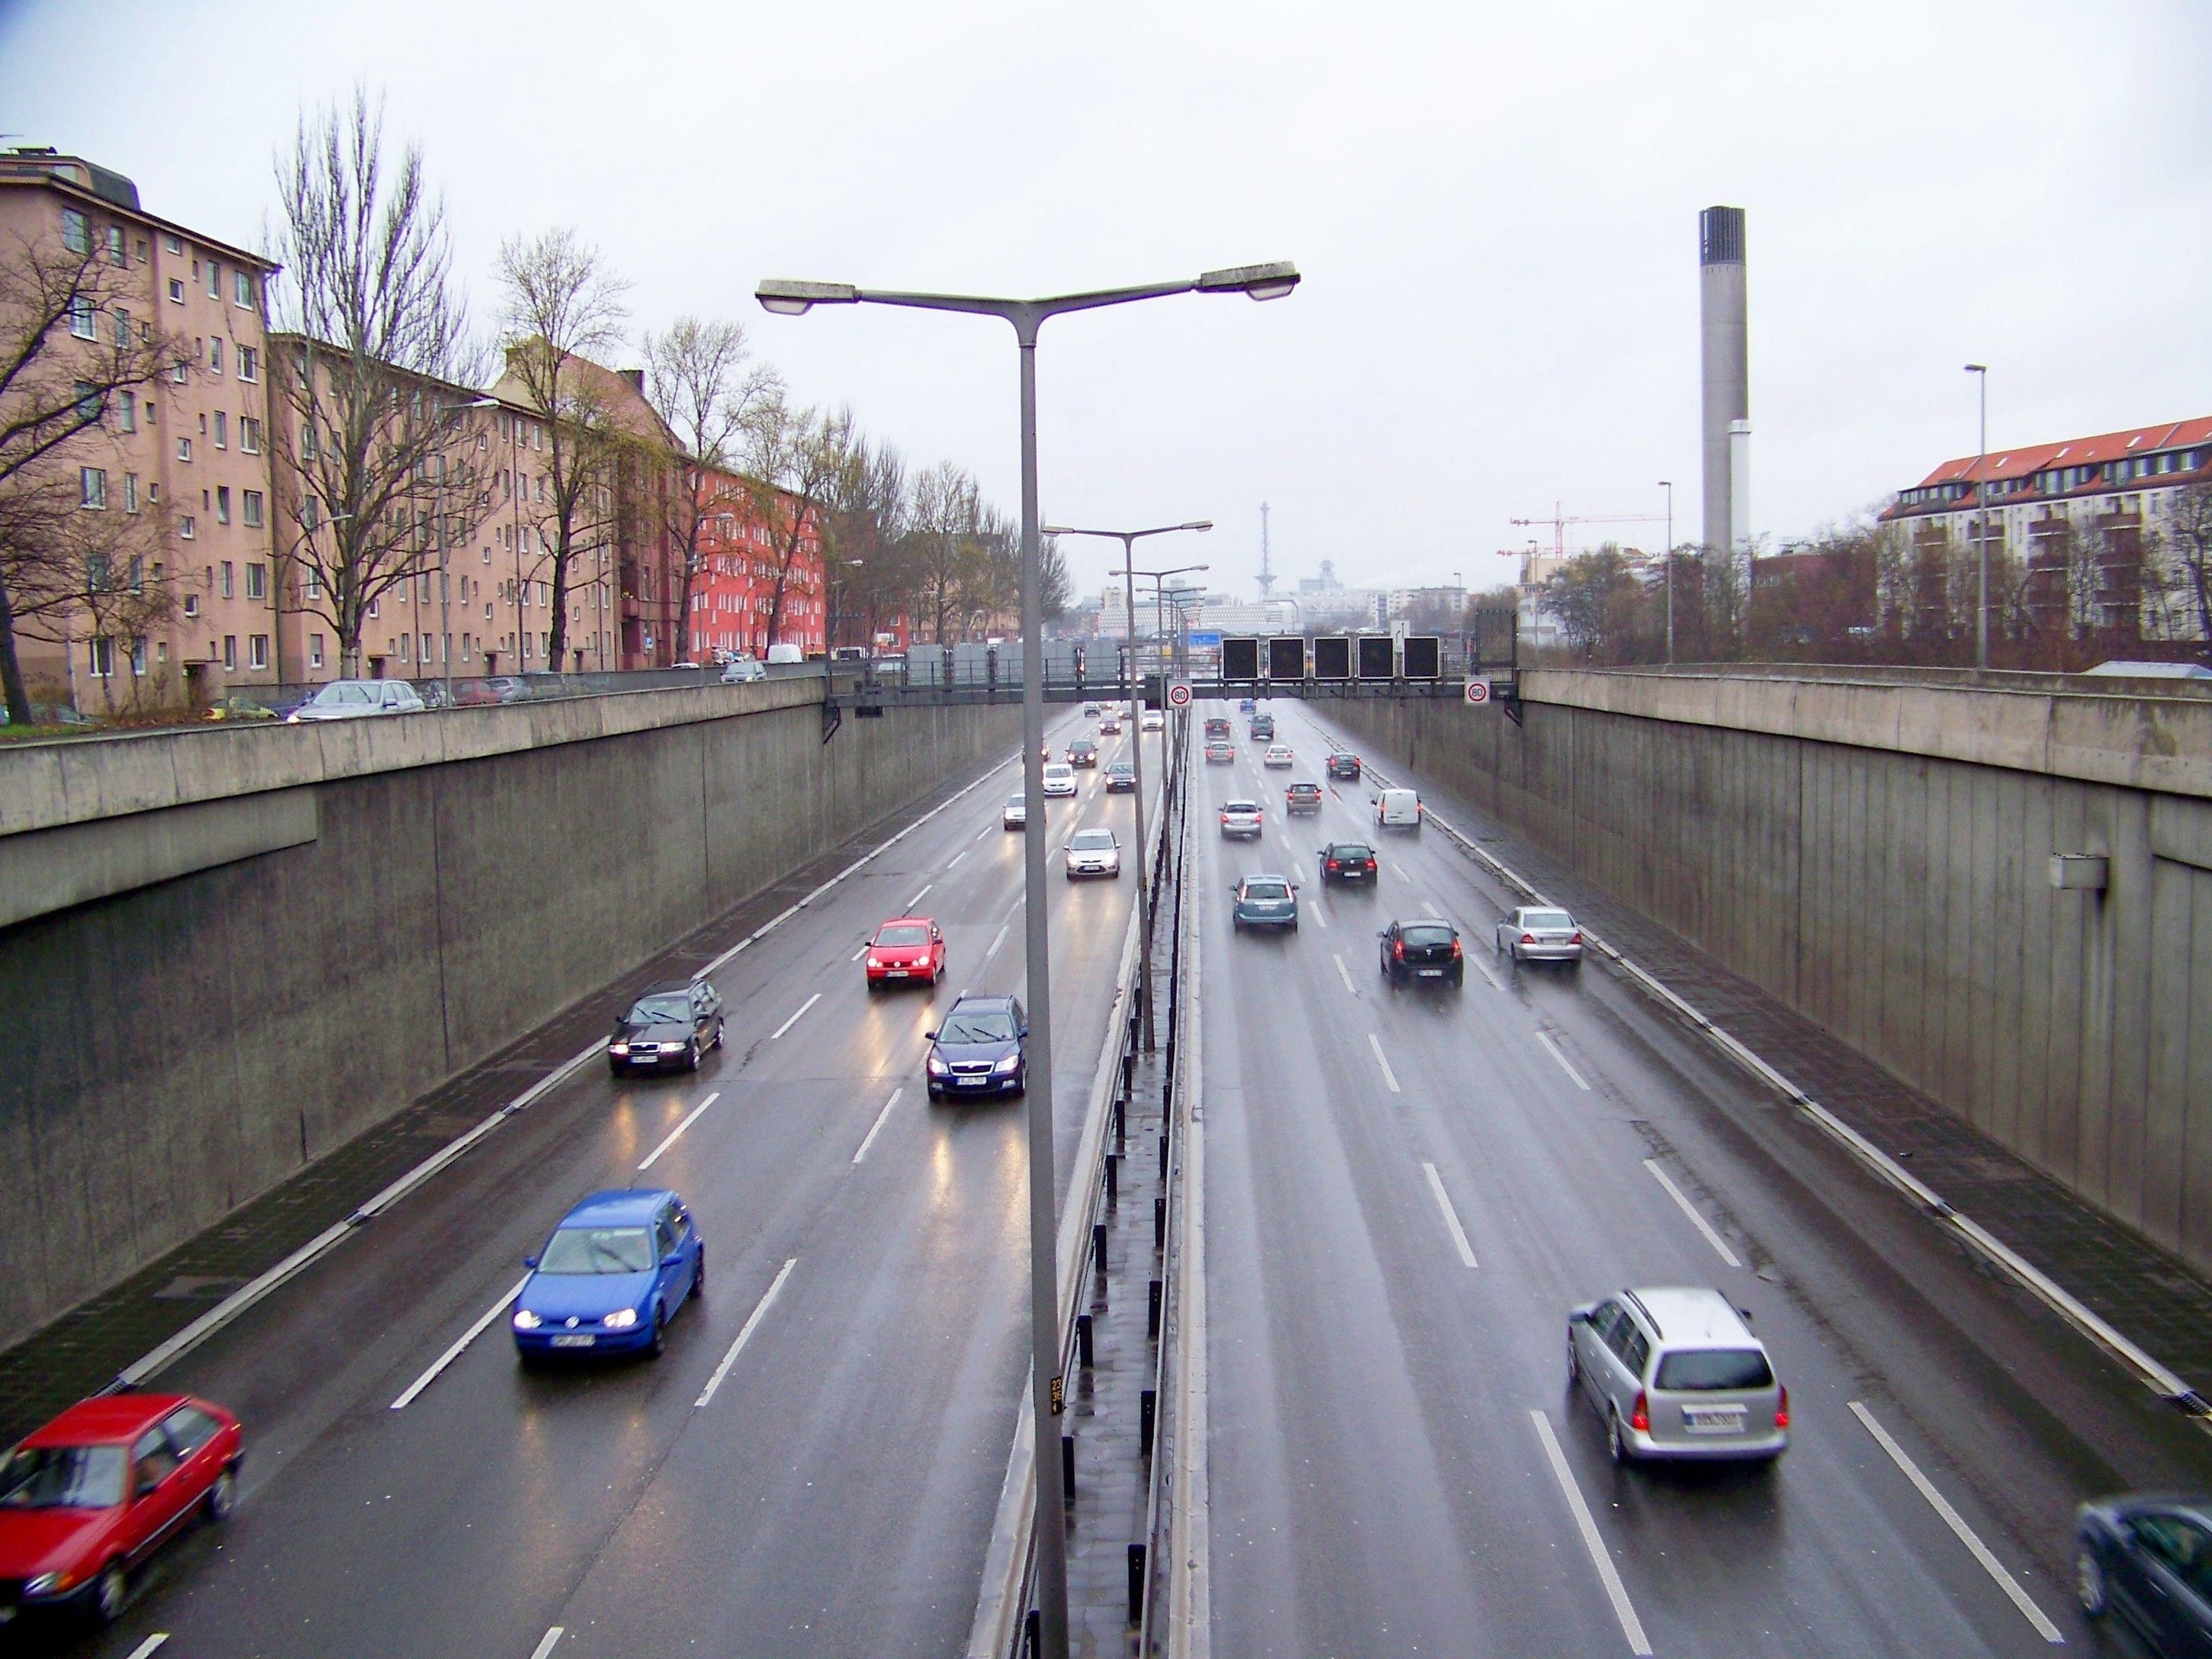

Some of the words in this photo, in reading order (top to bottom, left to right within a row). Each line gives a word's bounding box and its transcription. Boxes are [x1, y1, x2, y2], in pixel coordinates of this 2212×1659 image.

[1175, 691, 1185, 699] 80
[1472, 688, 1482, 696] 80
[1052, 1378, 1062, 1391] 23
